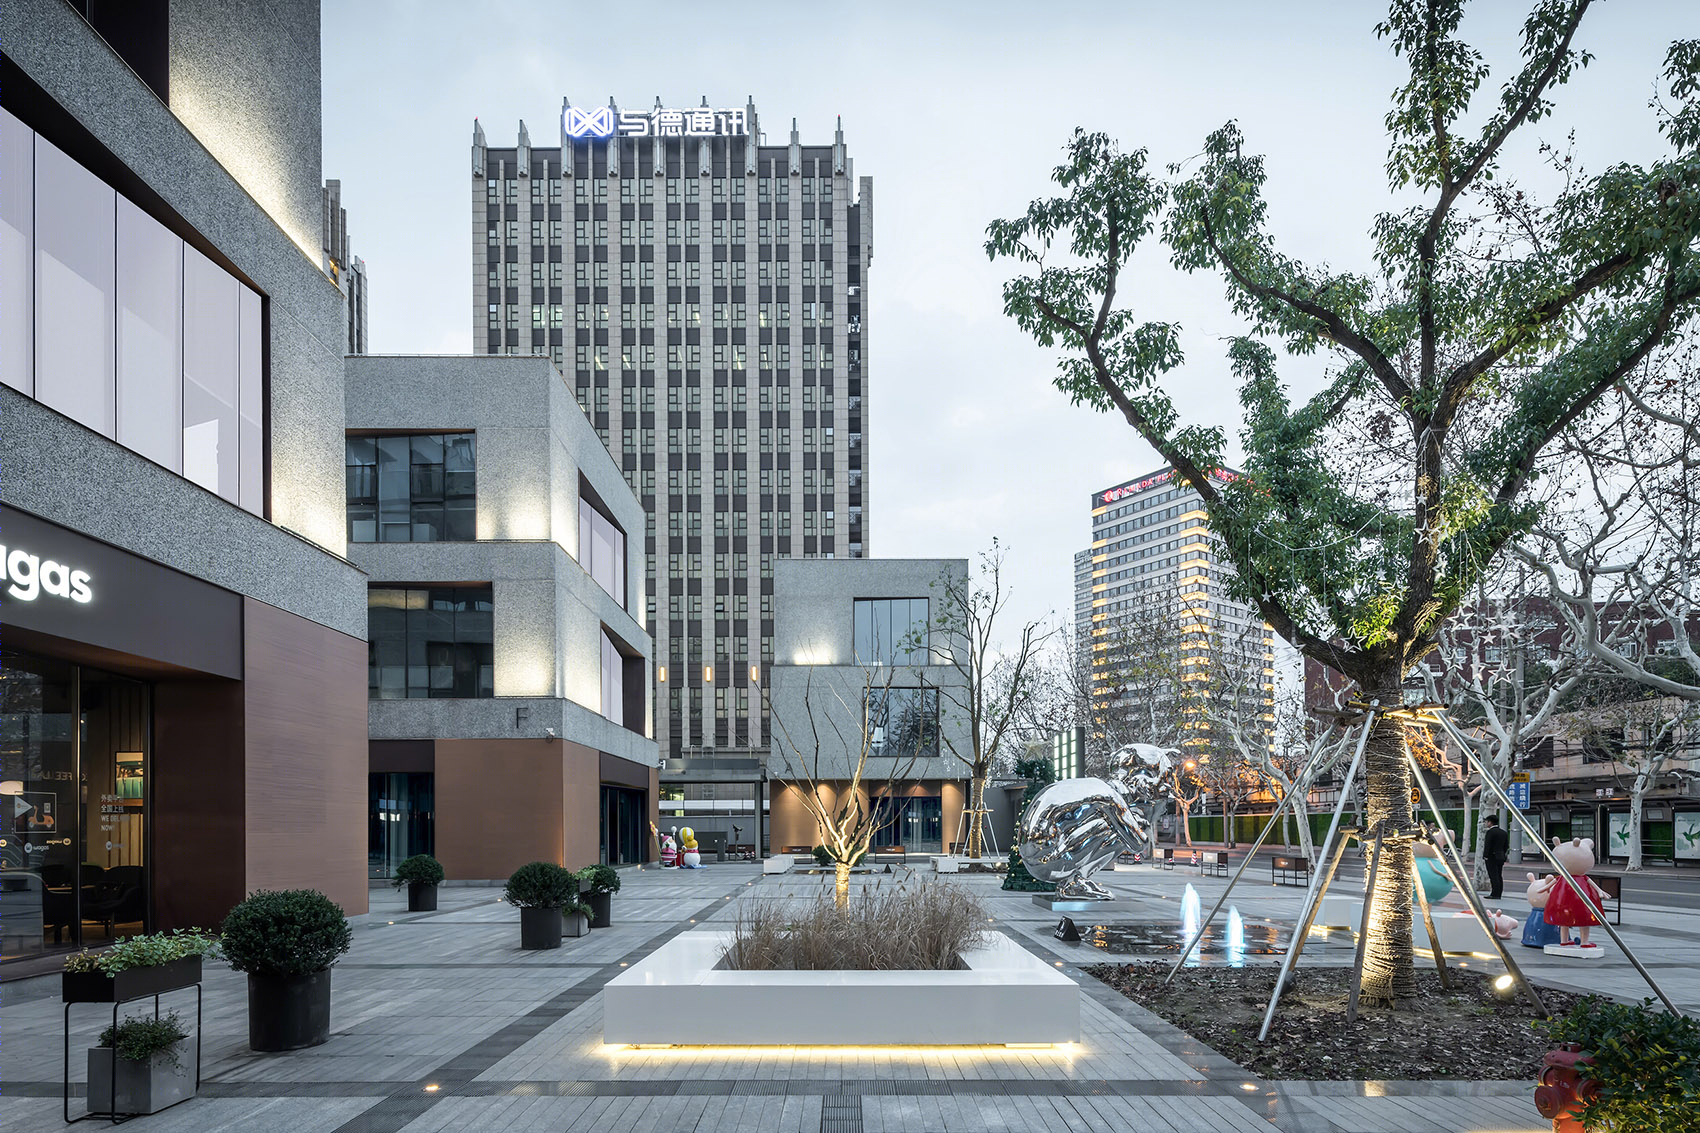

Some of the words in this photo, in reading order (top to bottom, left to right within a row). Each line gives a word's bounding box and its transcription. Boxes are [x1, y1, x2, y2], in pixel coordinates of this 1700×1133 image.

[618, 107, 749, 137] 与德通讯
[0, 544, 92, 604] gas
[516, 707, 529, 729] F
